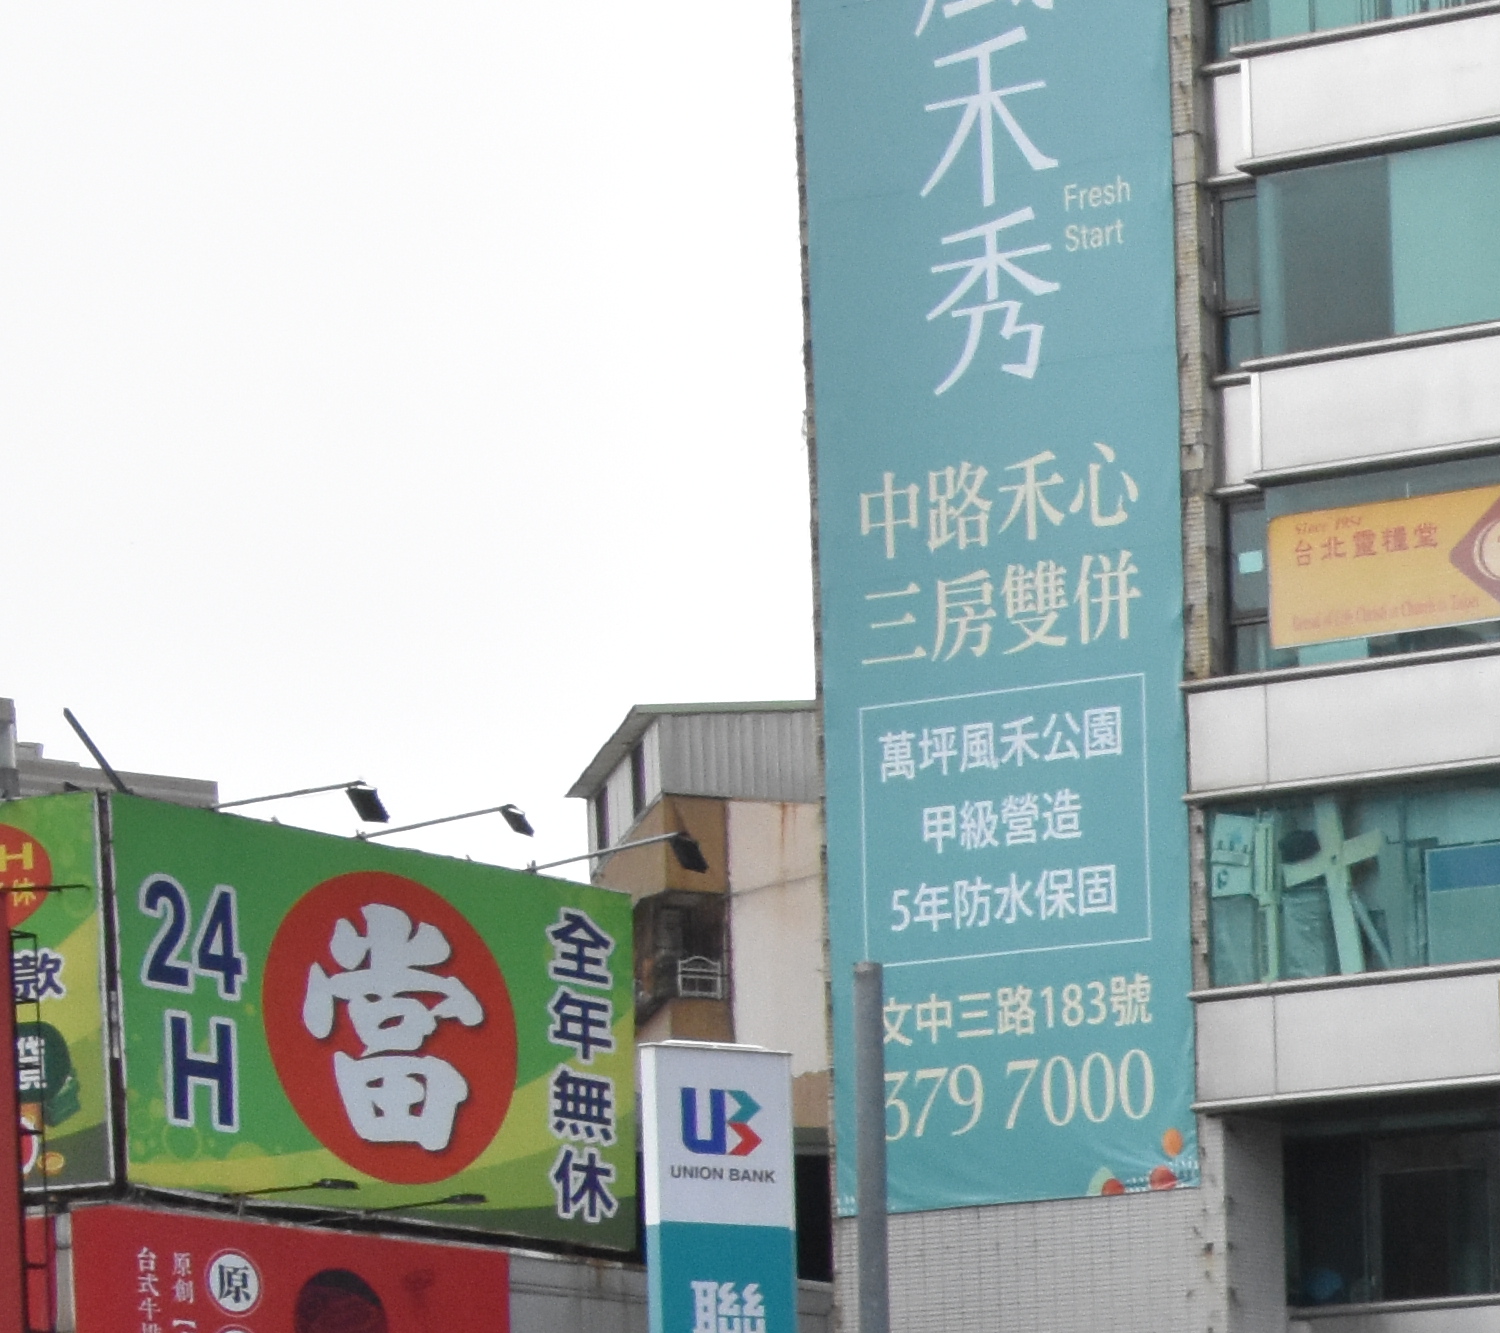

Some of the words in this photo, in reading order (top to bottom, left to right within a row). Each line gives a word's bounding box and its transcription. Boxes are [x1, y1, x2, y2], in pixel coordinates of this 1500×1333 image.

[913, 0, 1061, 396] 禾秀
[1063, 177, 1131, 212] Fresh
[1064, 219, 1125, 254] Start
[859, 441, 1140, 559] 中路禾心
[861, 549, 1142, 666] 三房雙併
[878, 705, 1123, 783] 萬坪風禾公園
[922, 788, 1083, 854] 甲級營造
[140, 876, 246, 1000] 24
[889, 864, 1118, 933] 5年防水保固
[302, 902, 485, 1152] 當
[882, 972, 1153, 1047] 文中三路183號
[165, 1012, 239, 1131] H
[549, 910, 617, 1220] 全年無休
[1005, 1048, 1155, 1130] 7000
[670, 1164, 724, 1182] UNION
[729, 1167, 776, 1184] BANK
